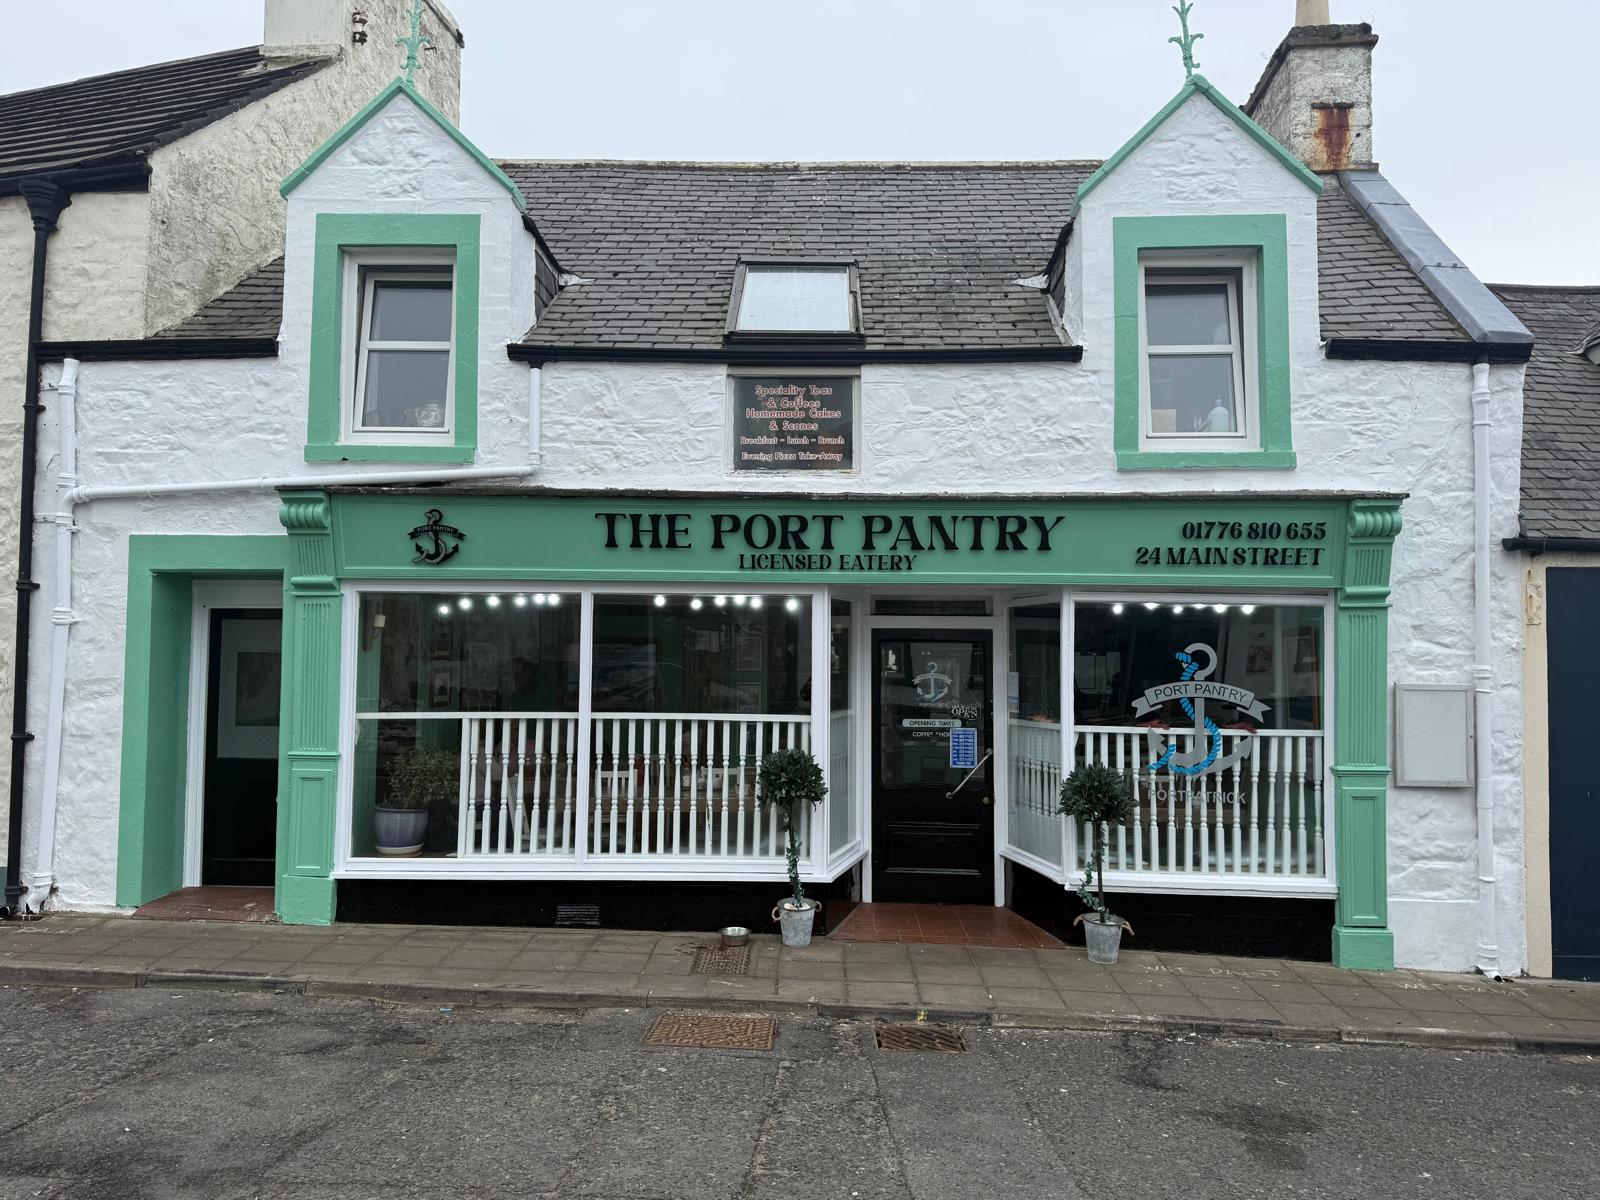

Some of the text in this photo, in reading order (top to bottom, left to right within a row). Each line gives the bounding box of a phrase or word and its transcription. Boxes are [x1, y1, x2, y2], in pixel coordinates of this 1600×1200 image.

[755, 385, 832, 397] Speciality Teas
[767, 396, 821, 408] & Coffees
[746, 408, 841, 418] Homemade Cakes
[769, 421, 818, 431] & Scones
[740, 436, 778, 444] Breakfast
[787, 436, 809, 444] Lunch
[818, 436, 845, 444] Brunch
[742, 452, 843, 461] Evening Pizza Take-Away
[594, 513, 1067, 551] THE PORT PANTRY
[1182, 521, 1327, 540] 01776 810 655
[738, 553, 918, 571] LICENSED EATERY
[1135, 546, 1326, 566] 24 MAIN STREET
[1154, 683, 1248, 702] PORT PANTRY
[951, 707, 978, 718] OPEN
[1147, 789, 1247, 804] PORTPATRICK
